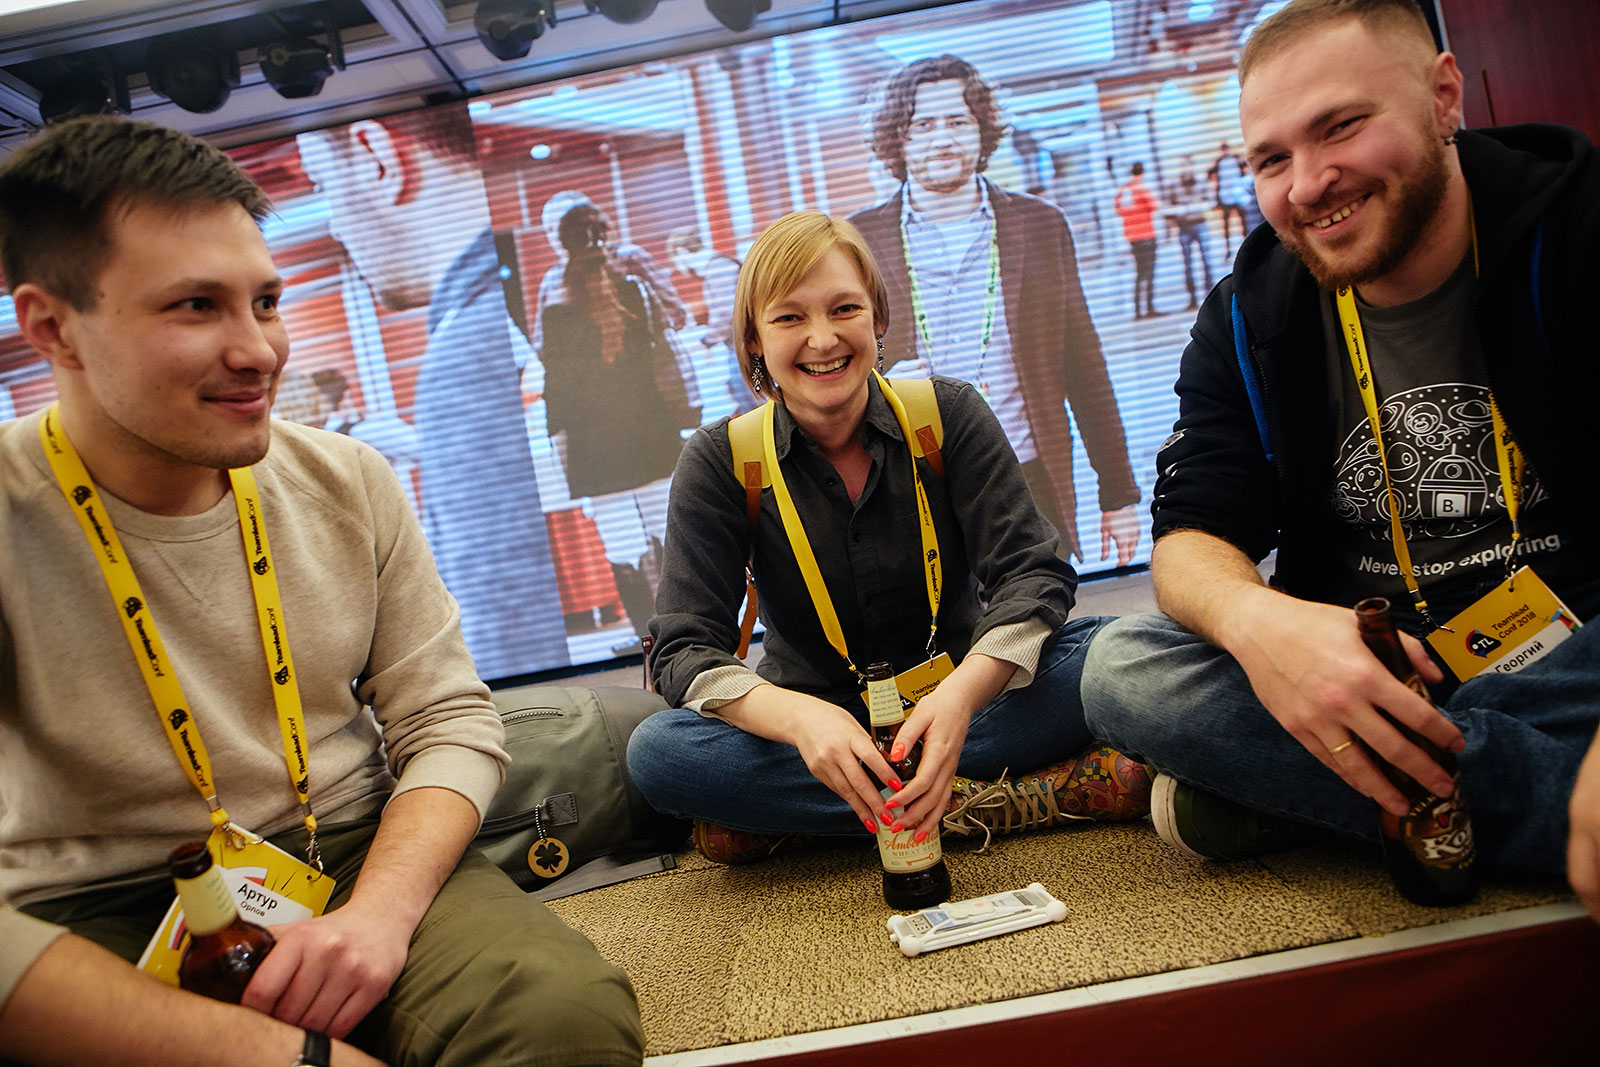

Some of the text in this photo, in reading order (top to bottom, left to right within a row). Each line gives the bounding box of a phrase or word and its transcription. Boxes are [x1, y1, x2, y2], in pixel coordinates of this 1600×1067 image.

[84, 504, 119, 564] TeamleadConf
[245, 498, 263, 556] TeamleadConf
[1358, 556, 1403, 576] Neve
[1412, 560, 1456, 576] stop
[1491, 604, 1530, 631] Teamlead
[1498, 611, 1537, 639] Conf 2018
[134, 617, 165, 678] TeamleadConf
[266, 607, 286, 666] TeamleadConf
[1494, 640, 1544, 673] Георгий
[911, 679, 941, 696] Teamlead
[180, 728, 209, 788] TeamleadConf
[288, 717, 308, 775] TeamleadConf
[237, 883, 278, 909] Артур
[240, 900, 265, 917] Орлов
